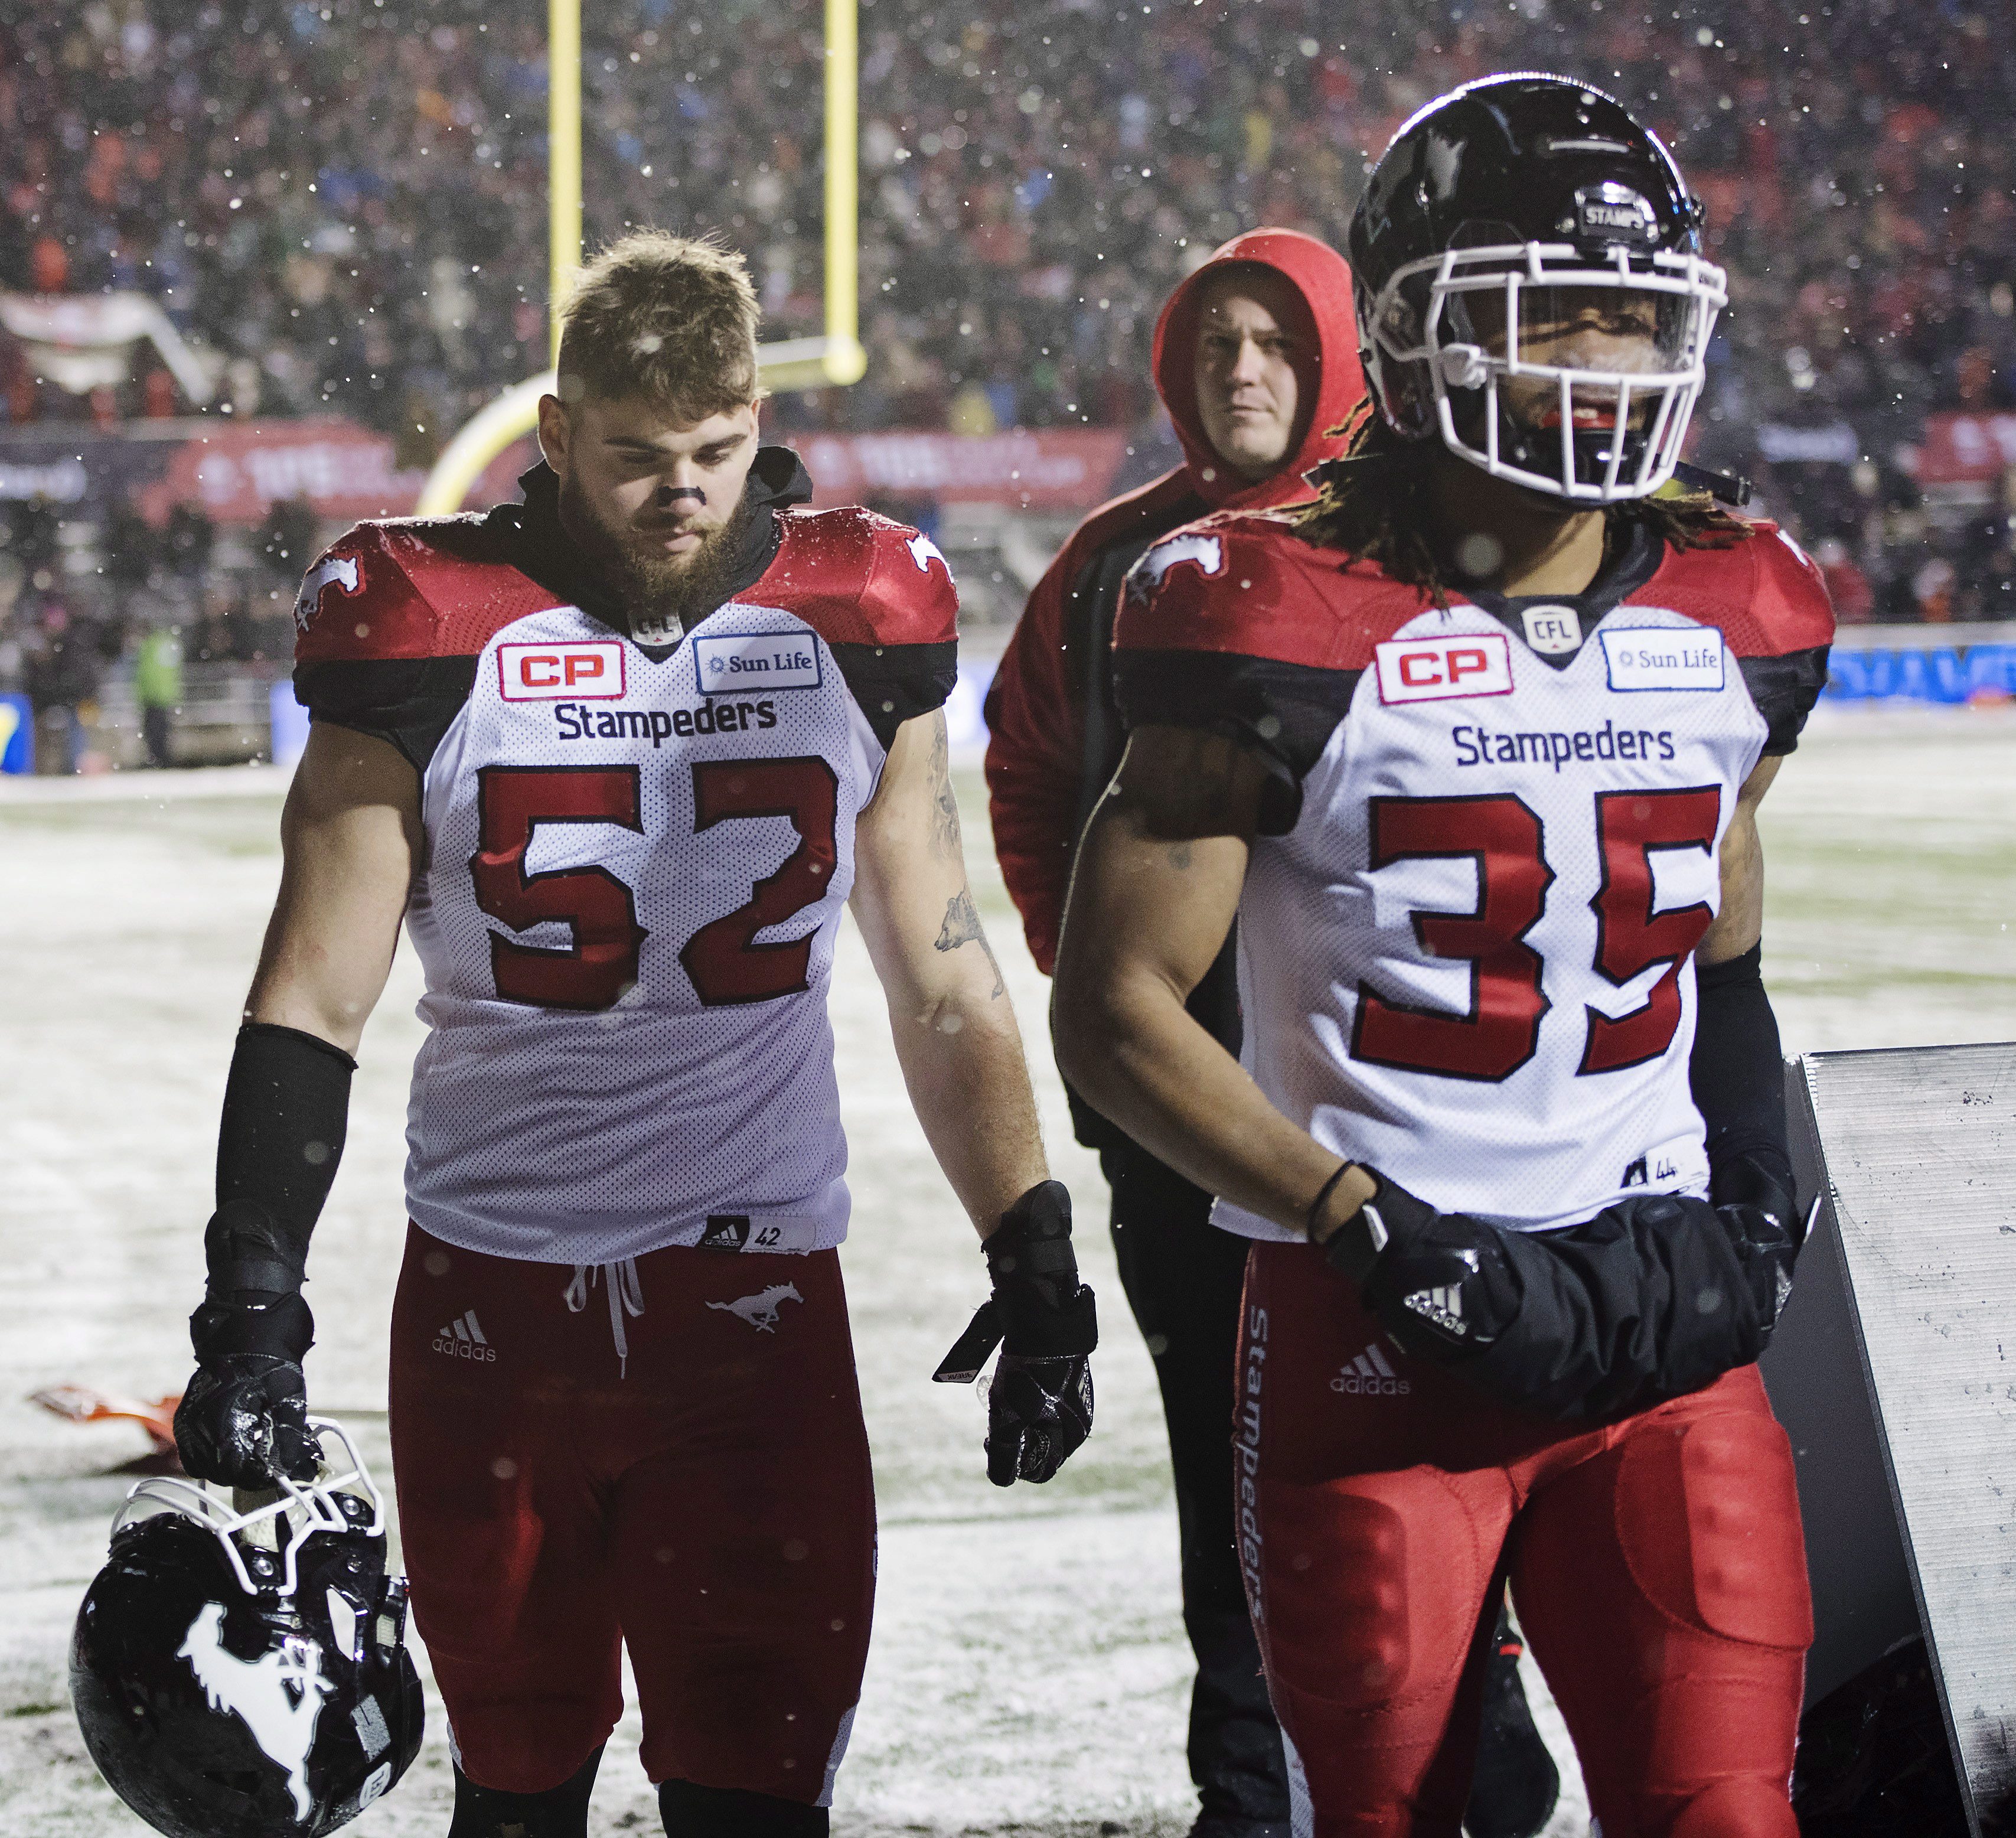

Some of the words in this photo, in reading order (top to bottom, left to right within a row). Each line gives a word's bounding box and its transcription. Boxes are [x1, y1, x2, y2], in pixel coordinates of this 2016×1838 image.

[1586, 207, 1645, 229] STAMPS
[1534, 620, 1571, 639] CFL
[520, 654, 604, 687] CP
[729, 656, 770, 673] Sun
[774, 653, 813, 672] Life
[1400, 649, 1487, 687] CP
[1639, 651, 1678, 669] Sun
[1684, 648, 1718, 669] Life
[554, 697, 778, 748] Stampeders
[1452, 719, 1675, 773] Stampeders
[468, 755, 839, 1012] 52
[1349, 784, 1722, 1083] 35
[704, 1237, 742, 1247] adidas
[754, 1227, 781, 1246] 42
[1403, 1293, 1468, 1335] adidas
[432, 1337, 497, 1362] adidas
[1330, 1375, 1412, 1395] adidas
[1237, 1305, 1268, 1625] Stampeders
